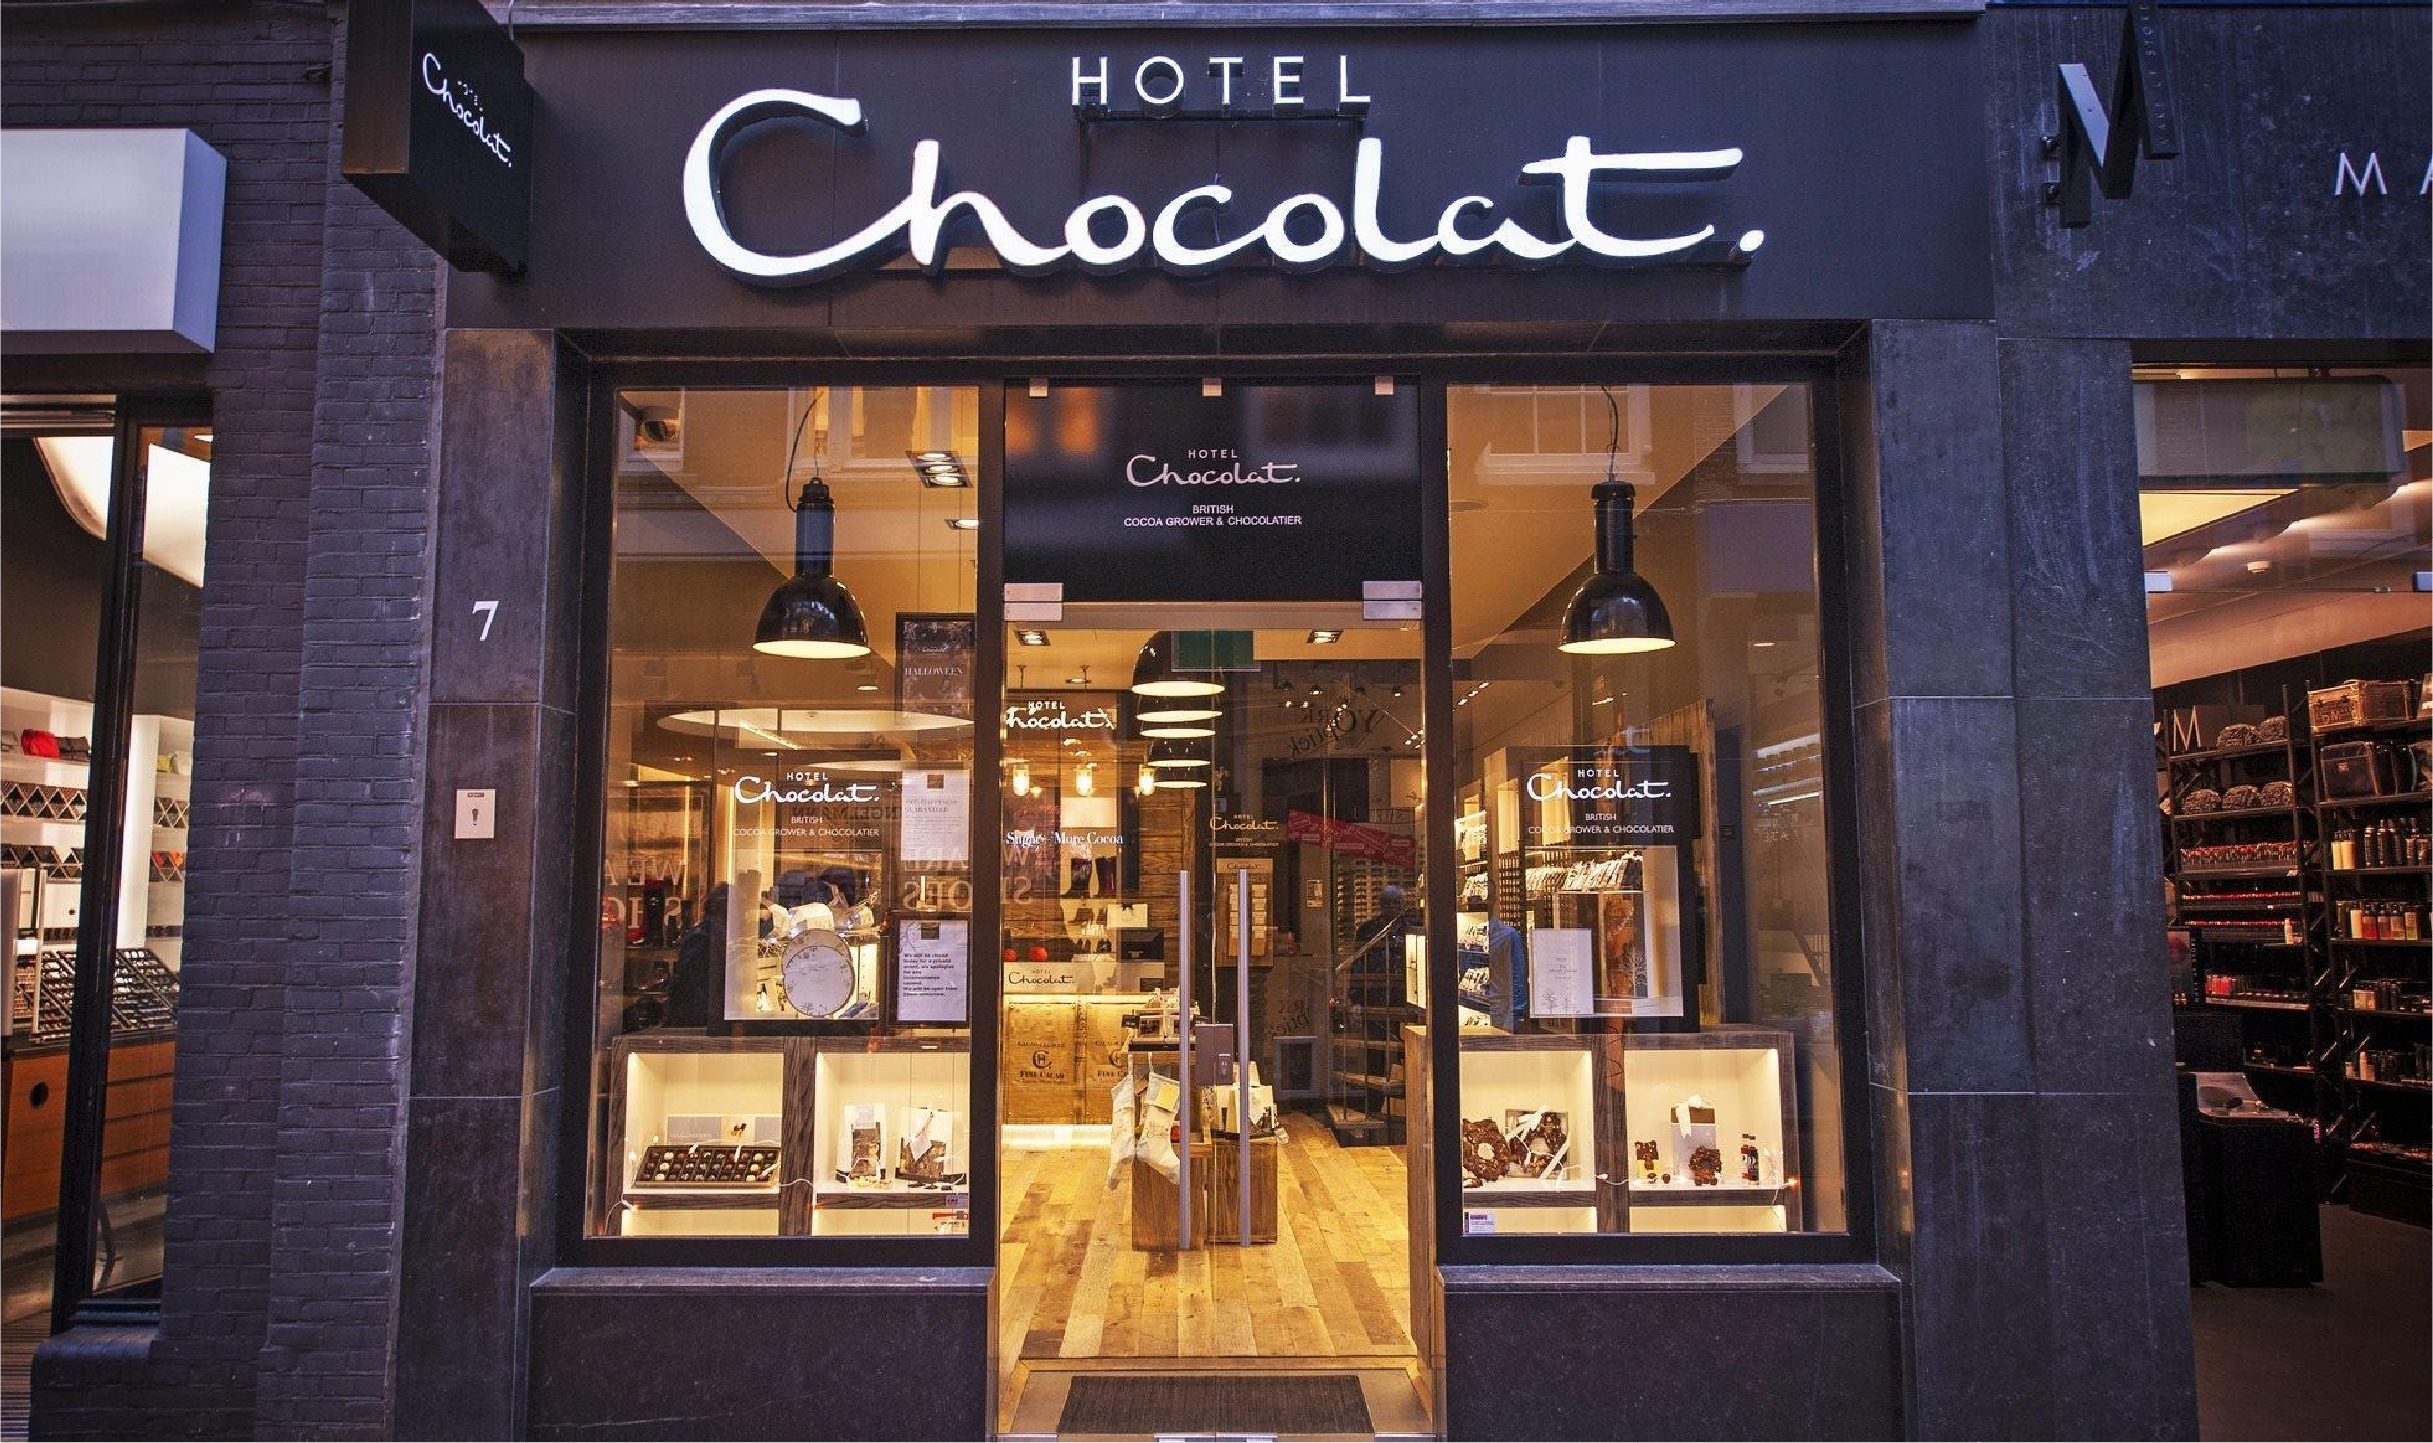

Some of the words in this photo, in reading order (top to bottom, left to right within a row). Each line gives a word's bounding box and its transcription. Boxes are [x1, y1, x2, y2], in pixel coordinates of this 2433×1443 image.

[1071, 55, 1371, 105] HOTEL
[682, 88, 1765, 277] Chocolat.
[1188, 449, 1239, 459] HOTEL
[1126, 453, 1301, 488] Chocolat.
[1192, 504, 1234, 514] BRITISH
[1123, 516, 1163, 526] COCOA
[1165, 516, 1214, 526] GROWER
[1215, 517, 1224, 526] &
[1227, 515, 1303, 526] CHOCOLATIER
[472, 600, 499, 642] 7
[904, 666, 963, 676] HALLOWEEN
[1028, 700, 1066, 710] HOTEL
[786, 771, 829, 781] HOTEL
[1577, 769, 1620, 778] HOTEL
[734, 775, 880, 804] Chocolat.
[1526, 772, 1672, 801] Chocolat.
[791, 816, 823, 824] BRITISH
[1585, 813, 1617, 821] BRITISH
[734, 828, 766, 836] COCOA
[769, 828, 807, 836] GROWER
[818, 828, 880, 836] CHOCOLATIER
[1612, 824, 1675, 834] CHOCOLATIER
[1087, 830, 1124, 845] Cocoa
